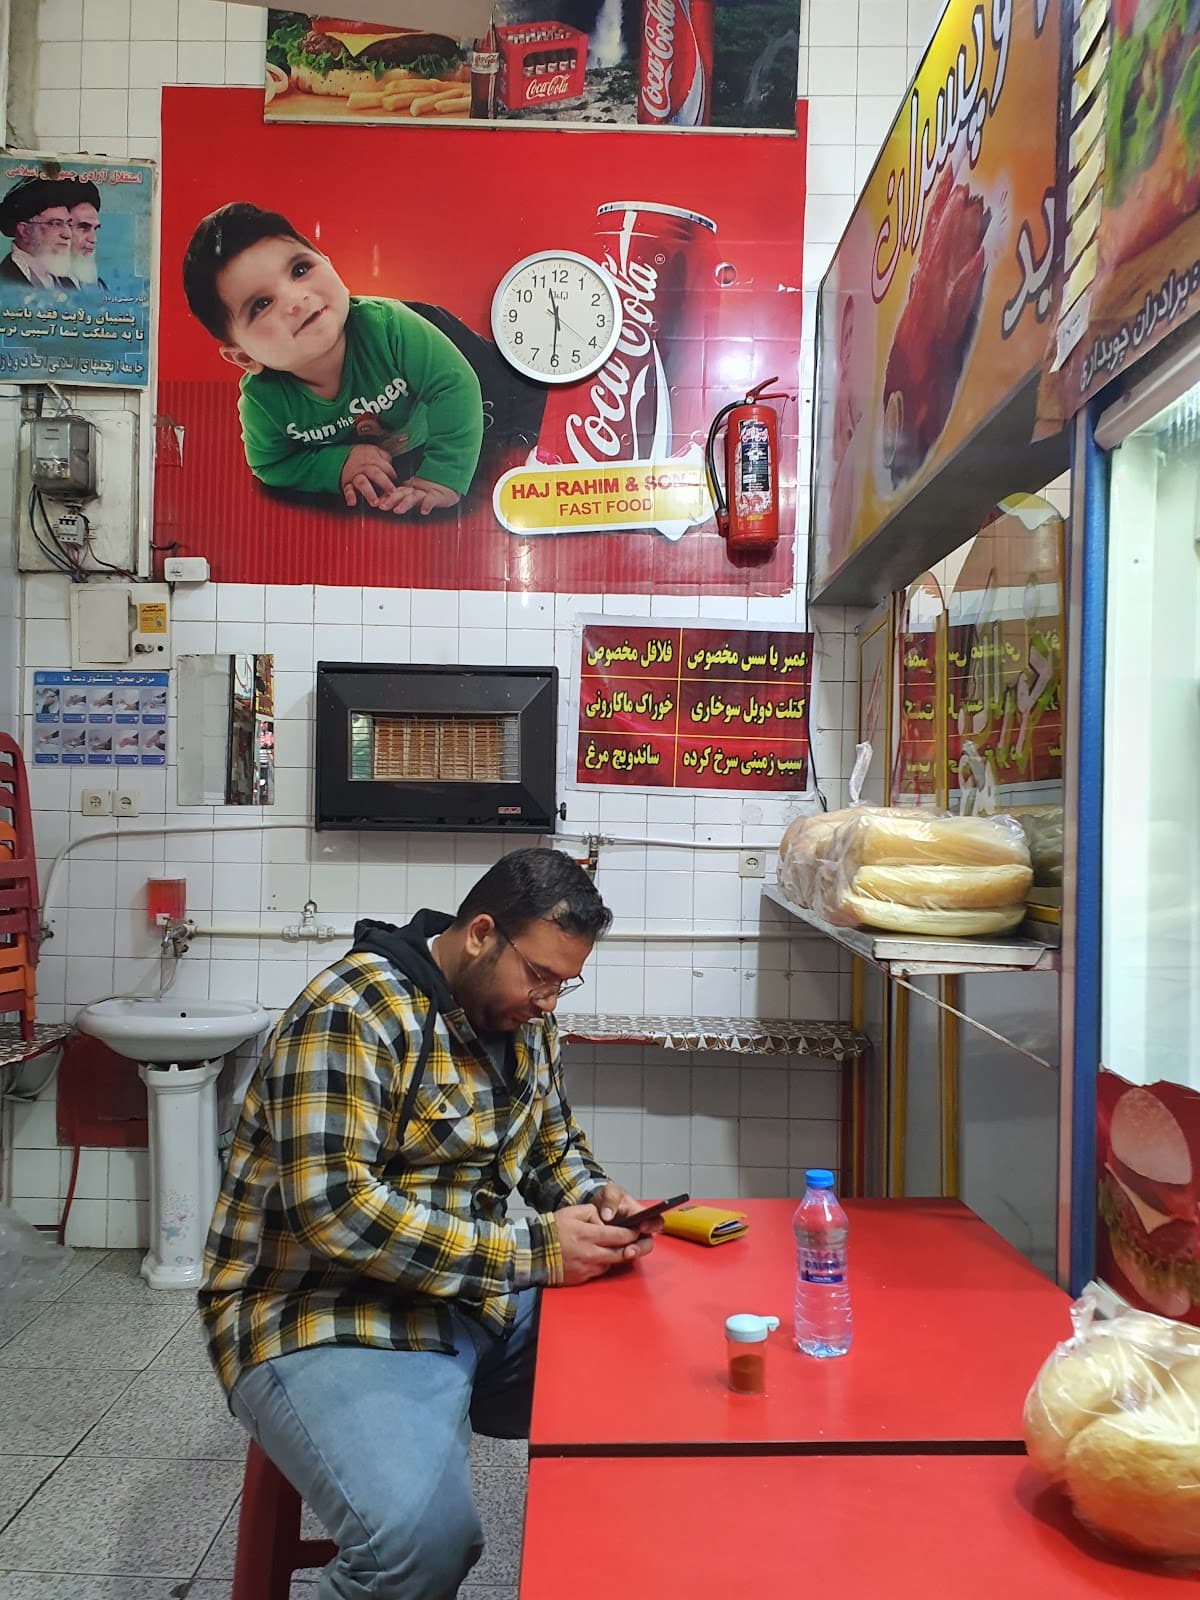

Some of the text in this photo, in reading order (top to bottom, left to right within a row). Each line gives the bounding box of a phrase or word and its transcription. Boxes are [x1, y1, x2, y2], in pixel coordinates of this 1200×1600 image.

[871, 4, 988, 304] پسران
[6, 165, 142, 184] استقلال آزادی جمهی اسلامی
[532, 275, 546, 289] 11
[552, 270, 569, 283] 12
[578, 277, 584, 290] 1
[516, 289, 533, 303] 10
[591, 293, 601, 307] 2
[2, 307, 136, 325] پشتیبان ولایت فقیه باشید
[508, 309, 518, 323] 9
[596, 314, 606, 328] 3
[0, 323, 145, 343] تا به مملکت شما آسیبی نرس
[514, 331, 524, 345] 8
[588, 335, 598, 349] 4
[1080, 273, 1189, 392] برادران چوبداری
[530, 347, 540, 361] 7
[550, 354, 560, 367] 6
[571, 349, 581, 363] 5
[337, 415, 356, 430] the
[349, 377, 409, 415] Sheep
[511, 472, 701, 500] HAJ RAHIM & SON
[559, 498, 654, 517] FAST FOOD
[586, 639, 673, 668] فلافل مخصوص
[686, 644, 739, 671] مخصوص
[740, 651, 766, 671] سس
[769, 645, 778, 671] با
[585, 690, 674, 721] خوراک ماکارونی
[690, 694, 805, 724] کتلت دوبل سوخاری
[584, 740, 660, 771] ساندویچ مرغ
[683, 746, 803, 777] سیب زمینی سرخ کرده
